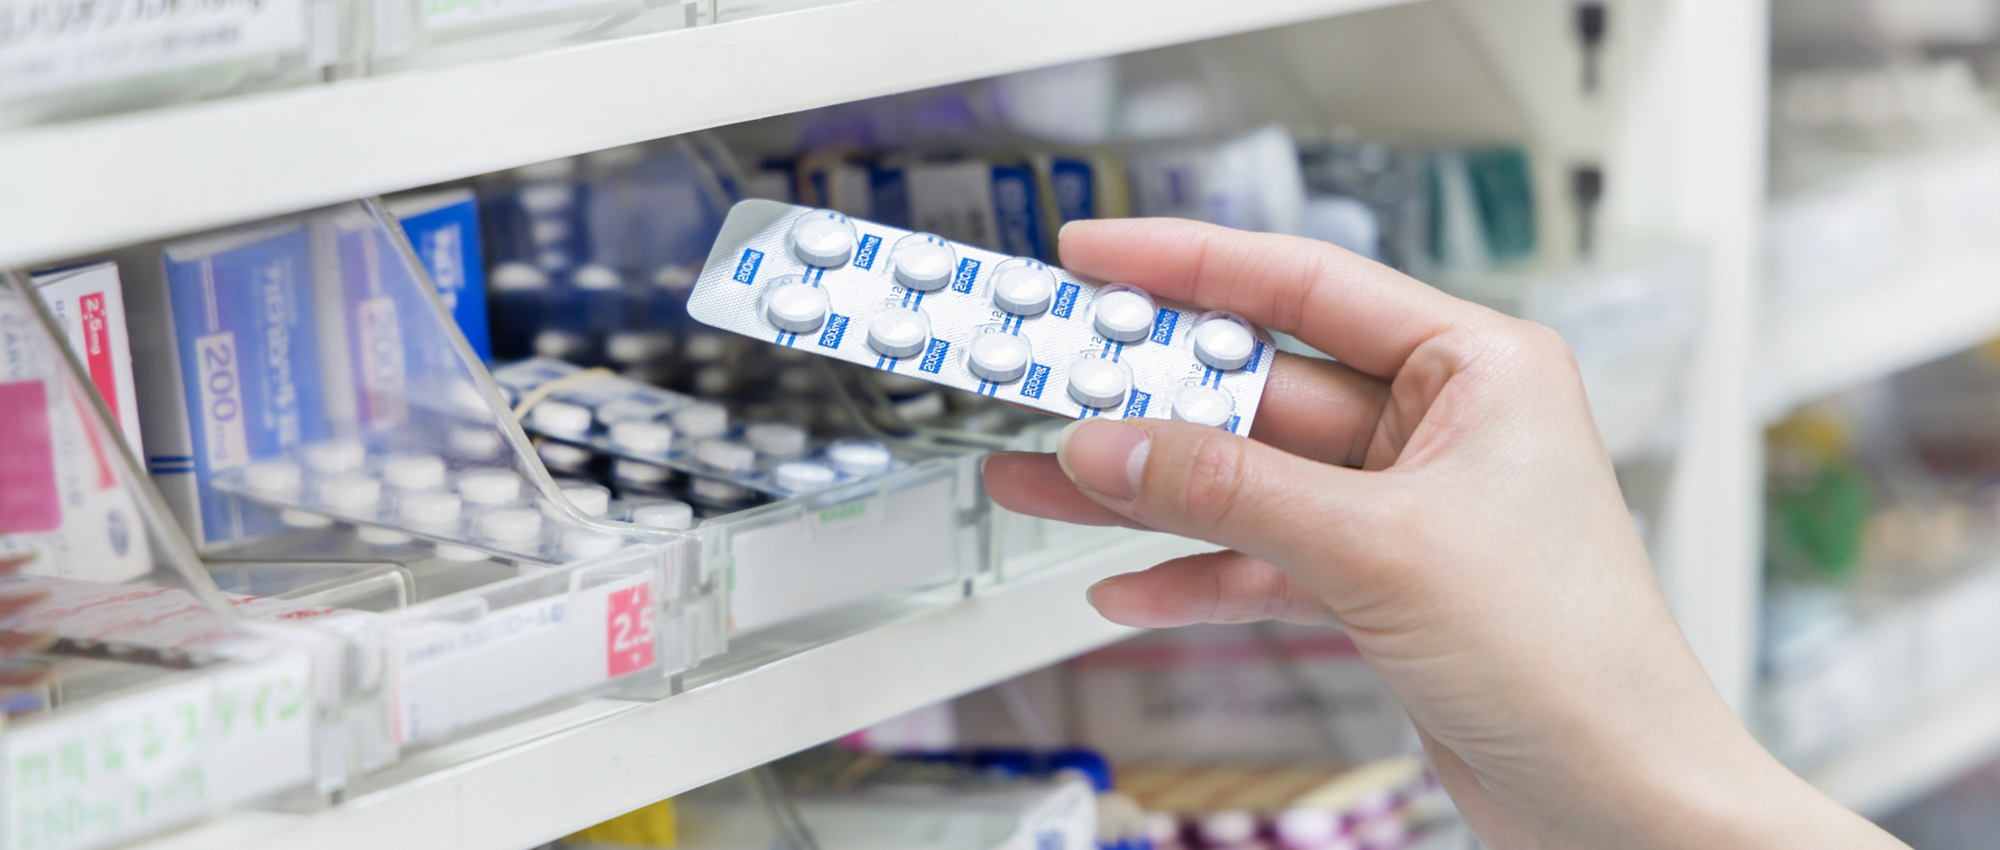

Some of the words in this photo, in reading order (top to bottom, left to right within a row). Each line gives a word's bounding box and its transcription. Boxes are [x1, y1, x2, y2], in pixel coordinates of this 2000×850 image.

[736, 250, 762, 283] 200mg
[854, 235, 880, 268] 200mg
[955, 259, 979, 292] 200mg
[1053, 284, 1077, 317] 200mg
[86, 297, 103, 355] 2.5mg
[822, 315, 848, 347] 200mg
[1154, 311, 1178, 343] 200mg
[922, 339, 947, 372] 200mg
[1024, 365, 1048, 397] 200mg
[613, 604, 655, 652] 2.5
